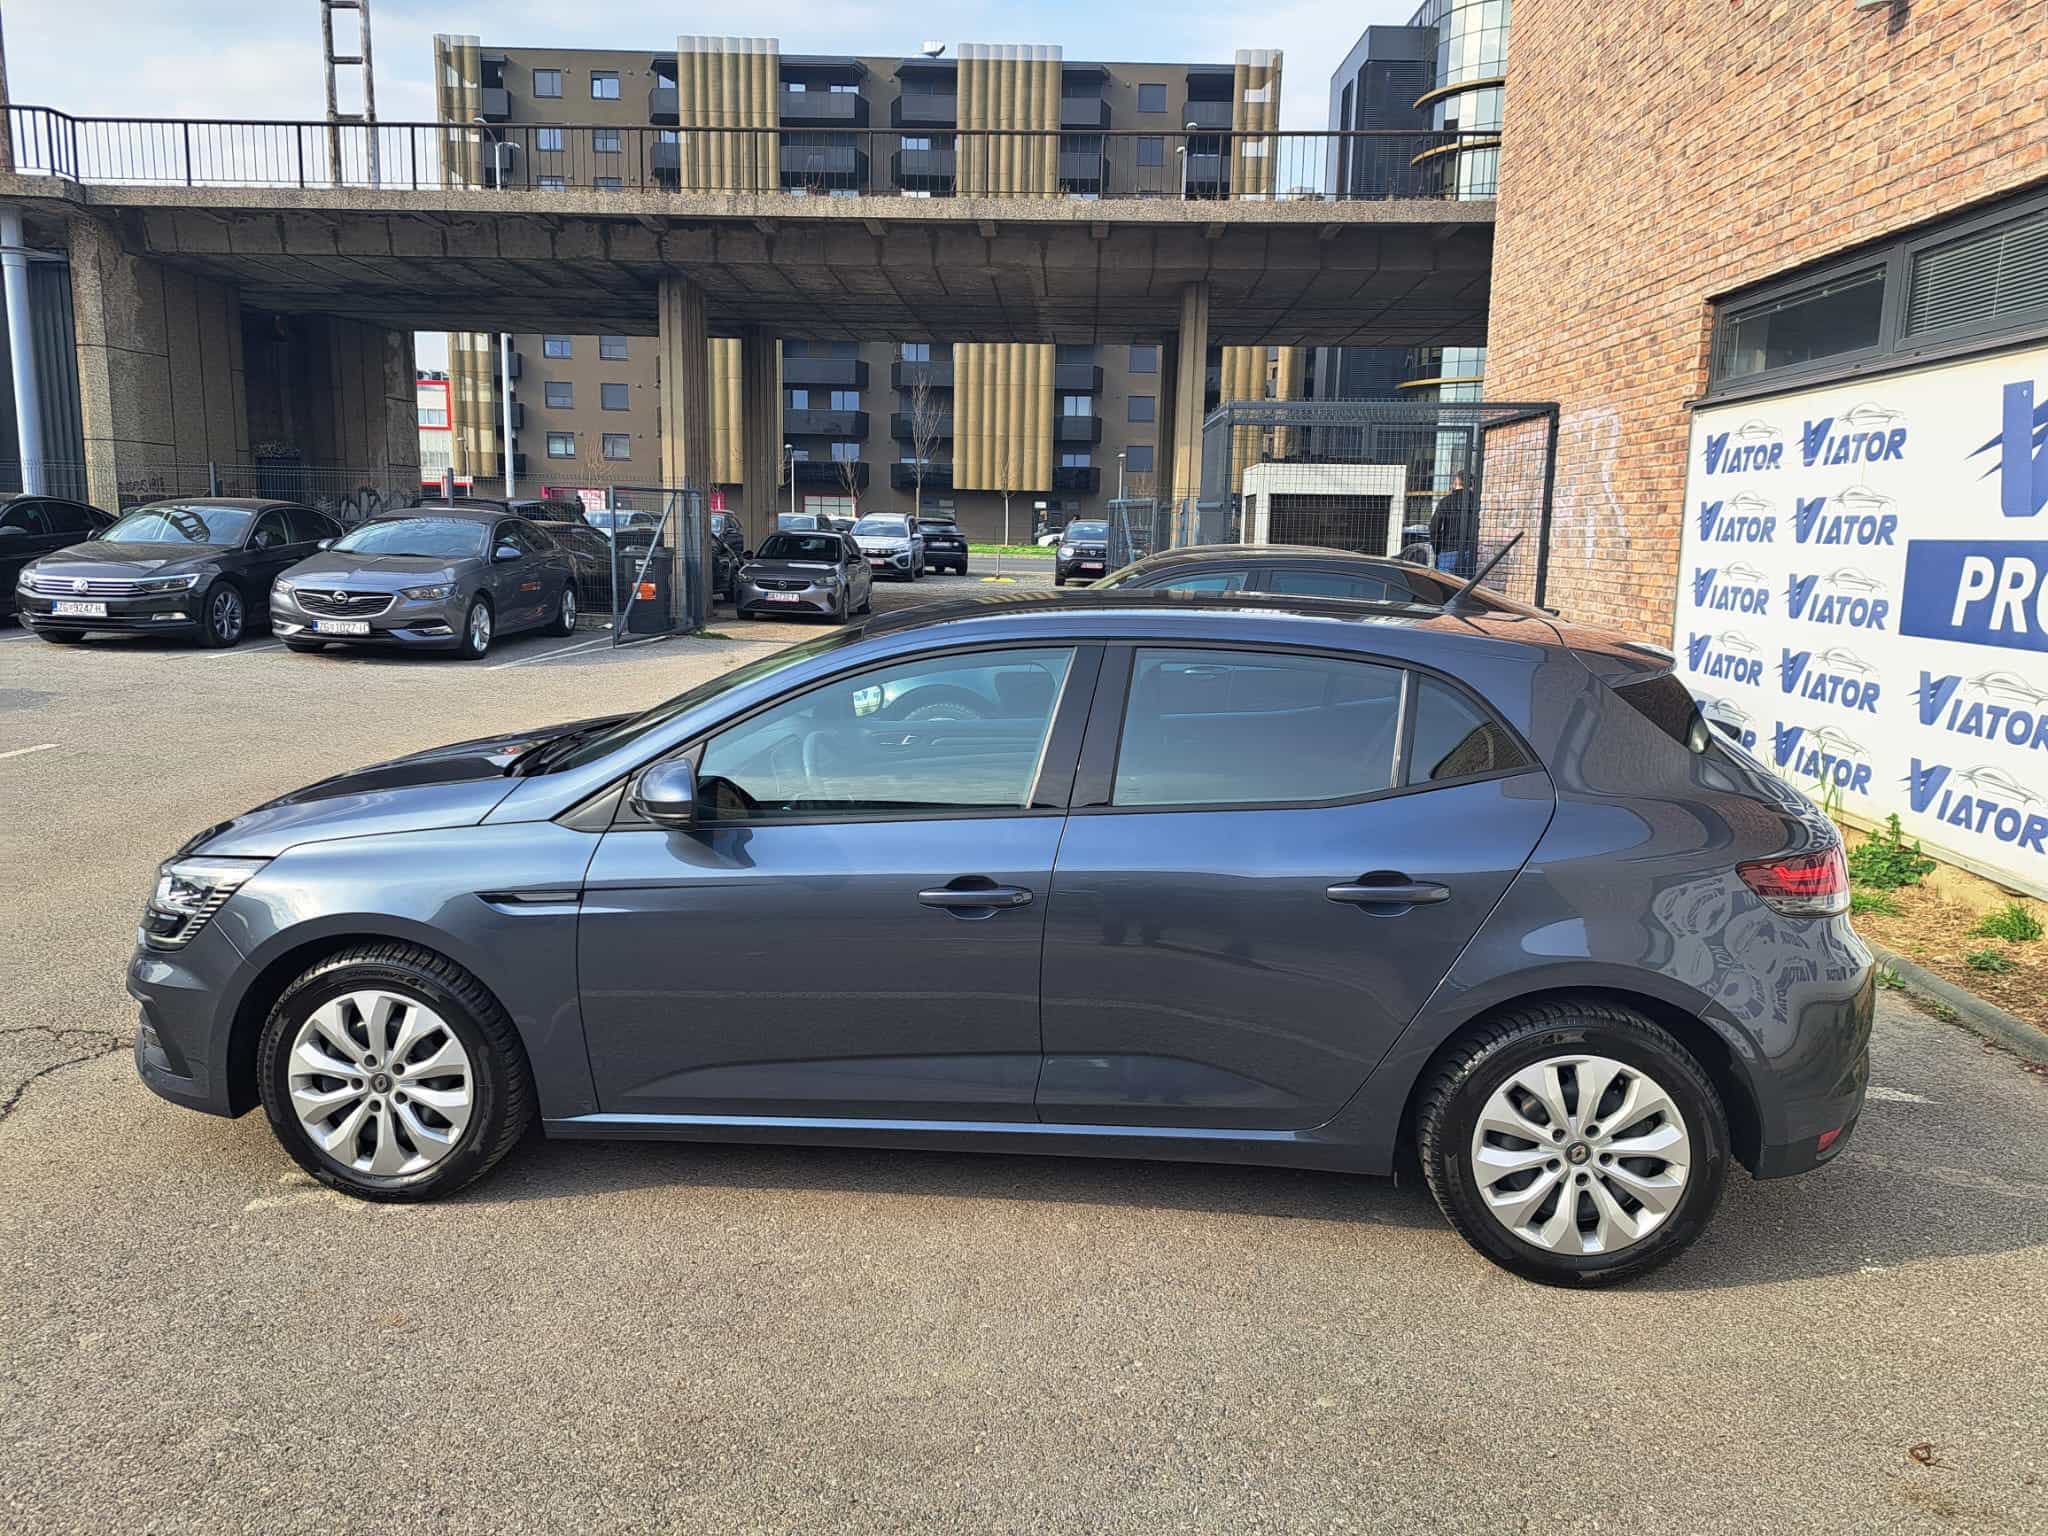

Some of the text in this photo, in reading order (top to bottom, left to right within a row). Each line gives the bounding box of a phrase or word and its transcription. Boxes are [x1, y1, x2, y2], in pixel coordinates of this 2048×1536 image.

[1704, 431, 1784, 477] VIATOR
[1801, 415, 1908, 468] VIATOR
[1699, 499, 1777, 544] VIATOR
[1793, 495, 1898, 546] VIATOR
[1693, 566, 1770, 615] VIATOR
[1786, 574, 1889, 631] VIATOR
[1687, 632, 1764, 688] VIATOR
[1780, 647, 1881, 714] VIATOR
[1916, 670, 2048, 751] VIATOR
[1773, 720, 1872, 795] VIATOR
[1908, 758, 2048, 855] VIATOR
